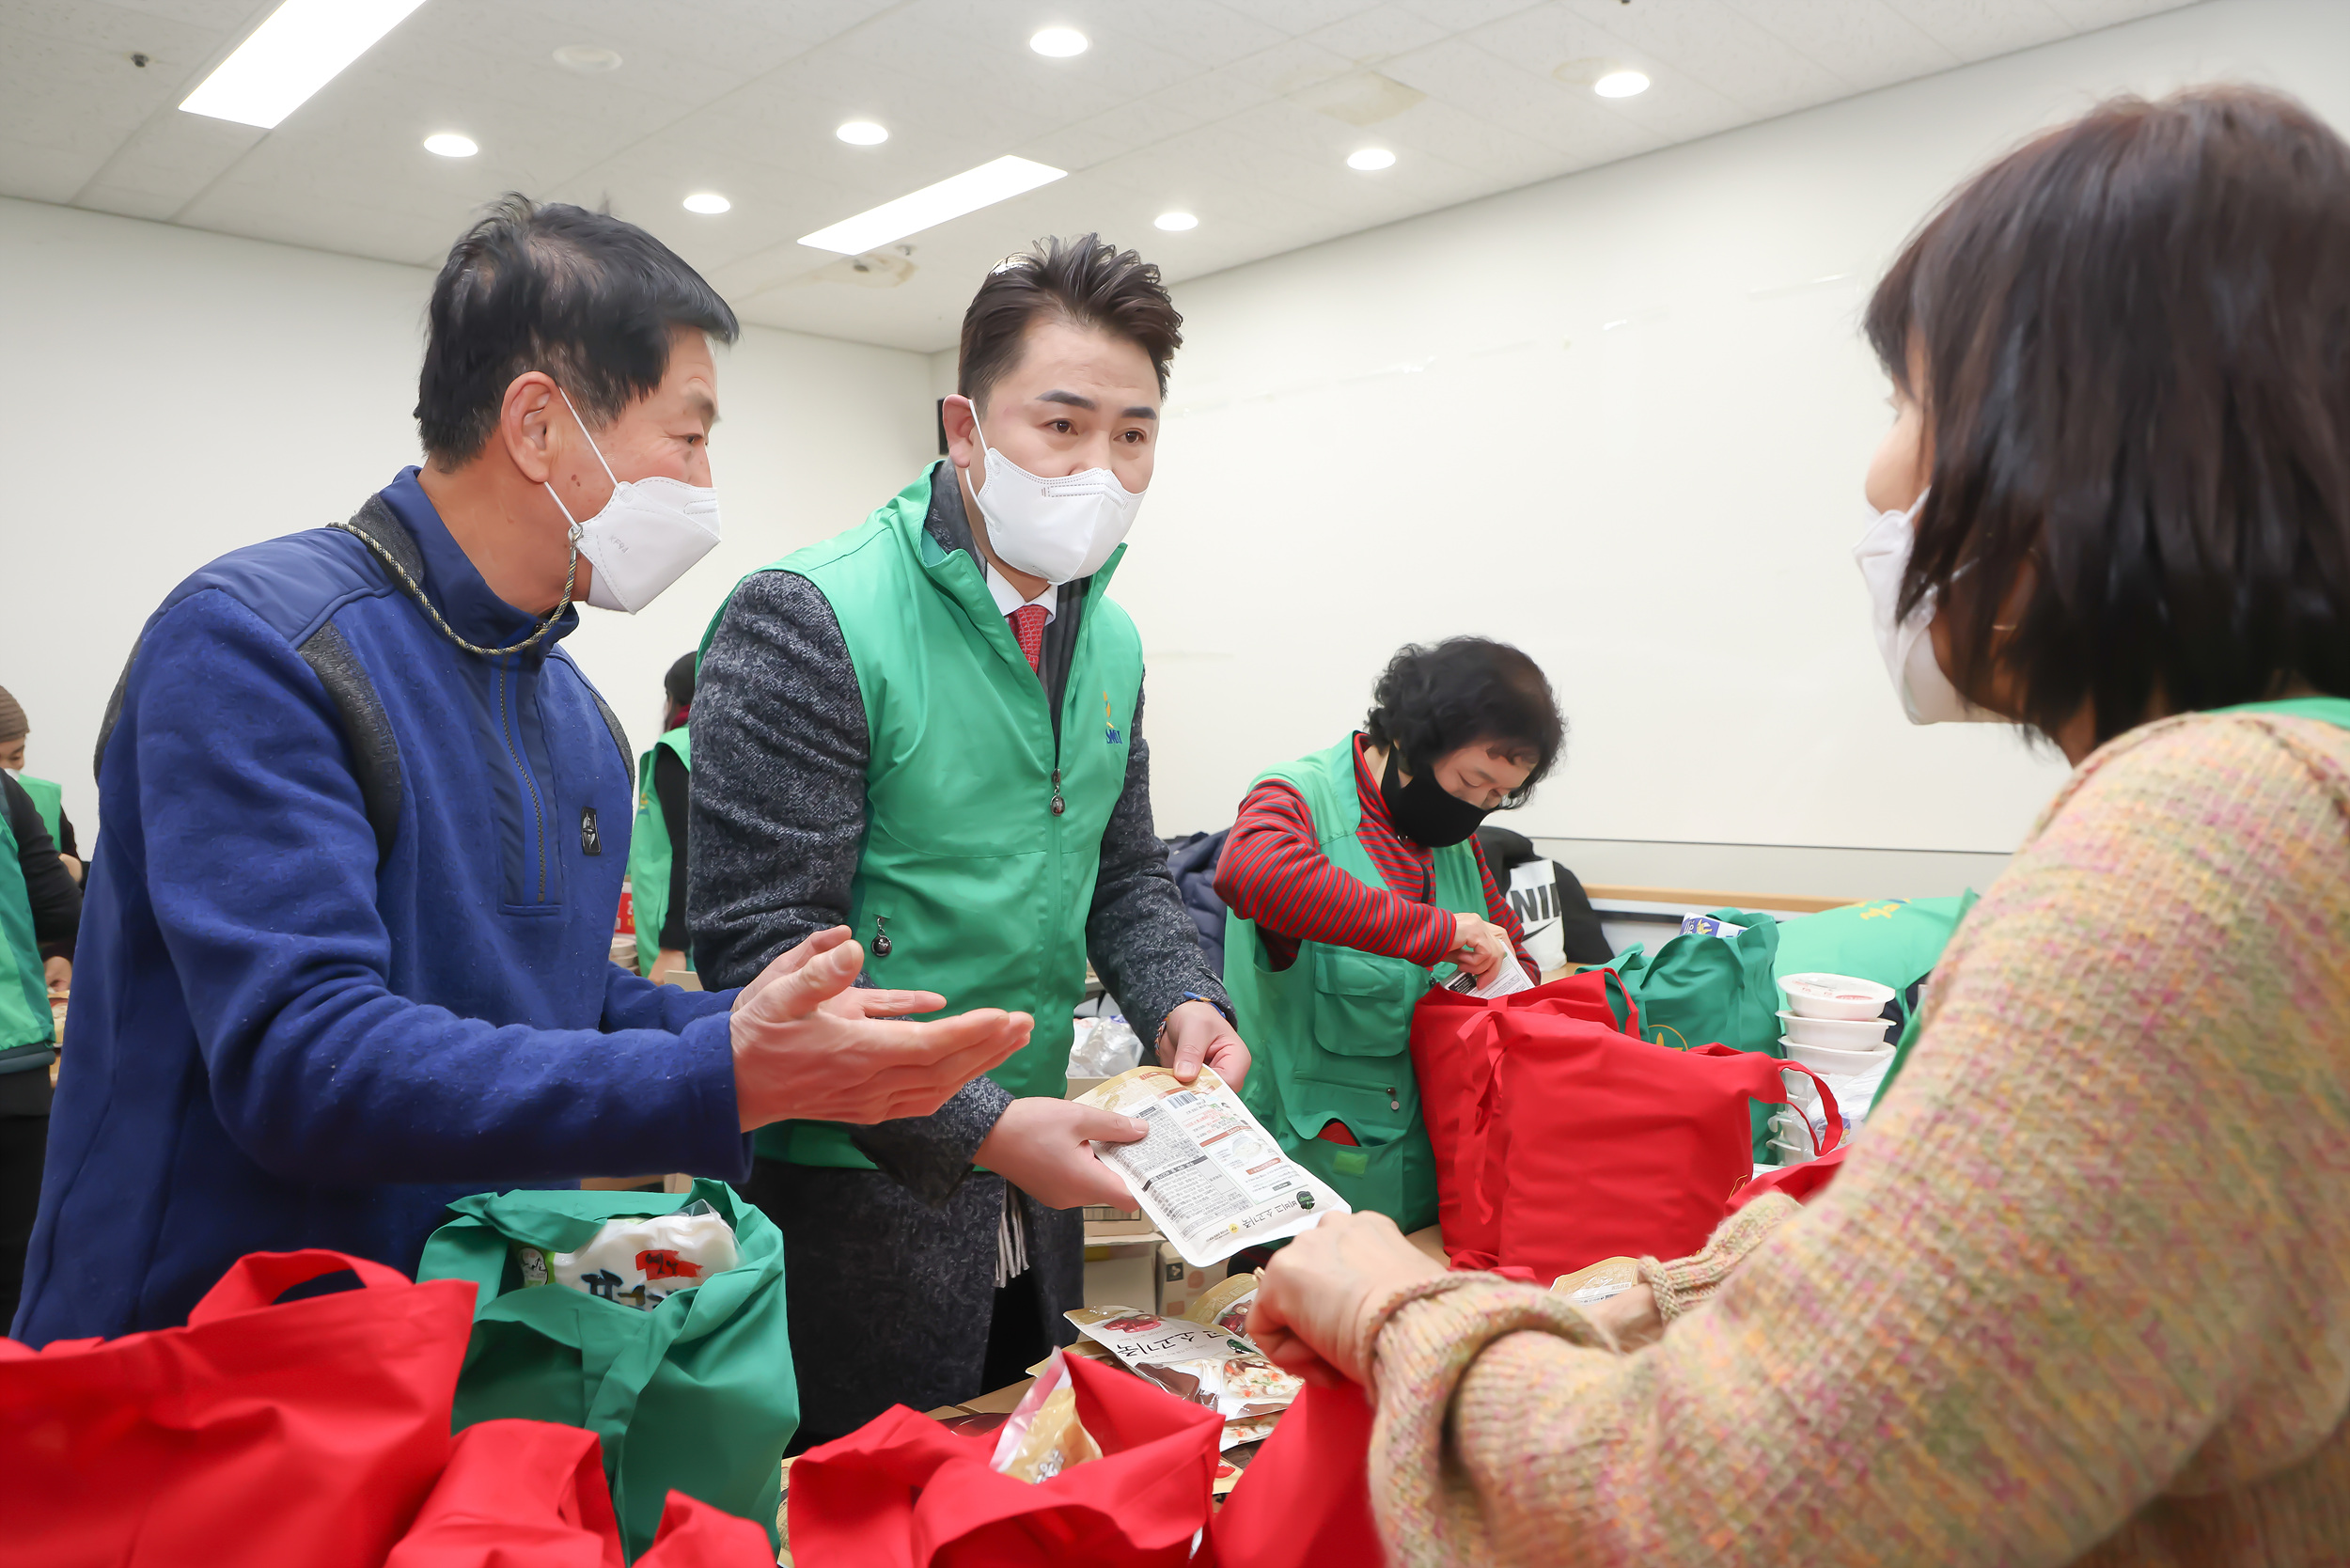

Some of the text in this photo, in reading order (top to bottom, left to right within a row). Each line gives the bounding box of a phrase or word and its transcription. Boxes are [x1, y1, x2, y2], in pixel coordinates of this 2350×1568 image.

[1242, 1200, 1297, 1229] 비비고 소고기죽
[1117, 1331, 1195, 1357] 소고기죽
